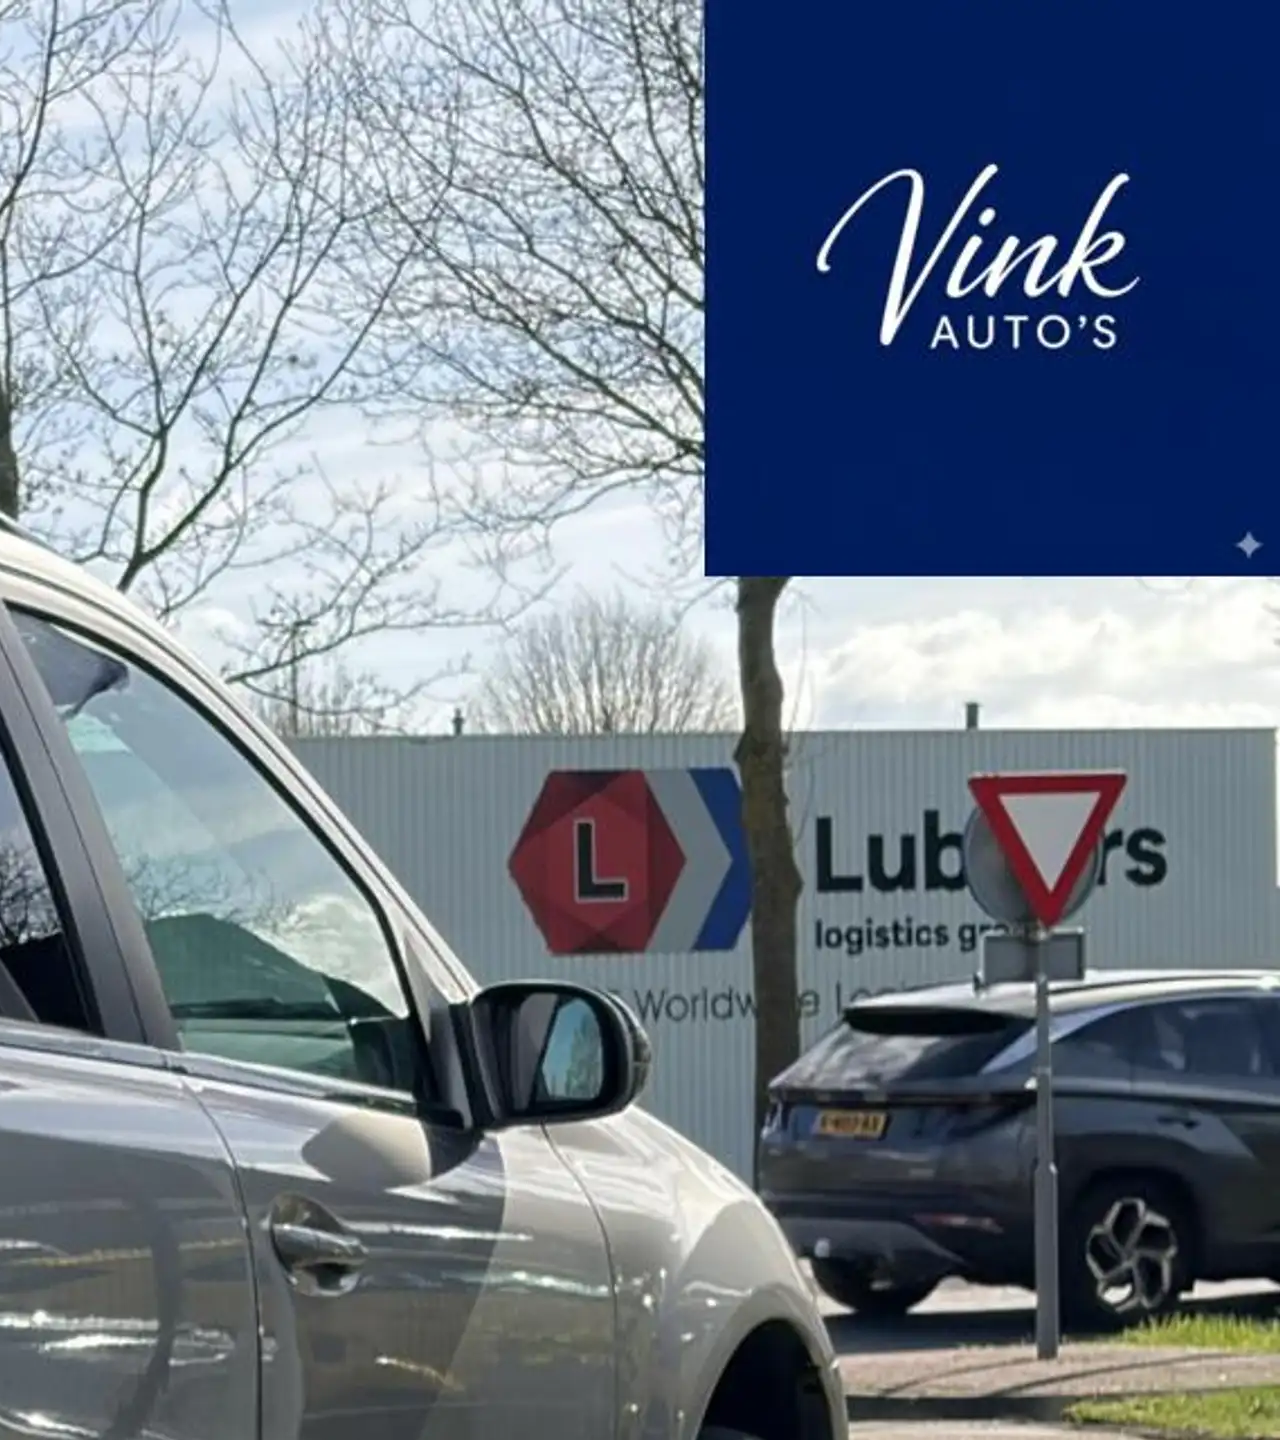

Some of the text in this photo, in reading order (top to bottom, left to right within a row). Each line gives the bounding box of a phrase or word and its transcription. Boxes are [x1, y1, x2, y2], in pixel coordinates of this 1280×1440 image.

[573, 818, 628, 903] L
[816, 810, 1167, 893] Lubrs
[815, 916, 949, 955] logistics
[634, 982, 820, 1024] Worldwe
